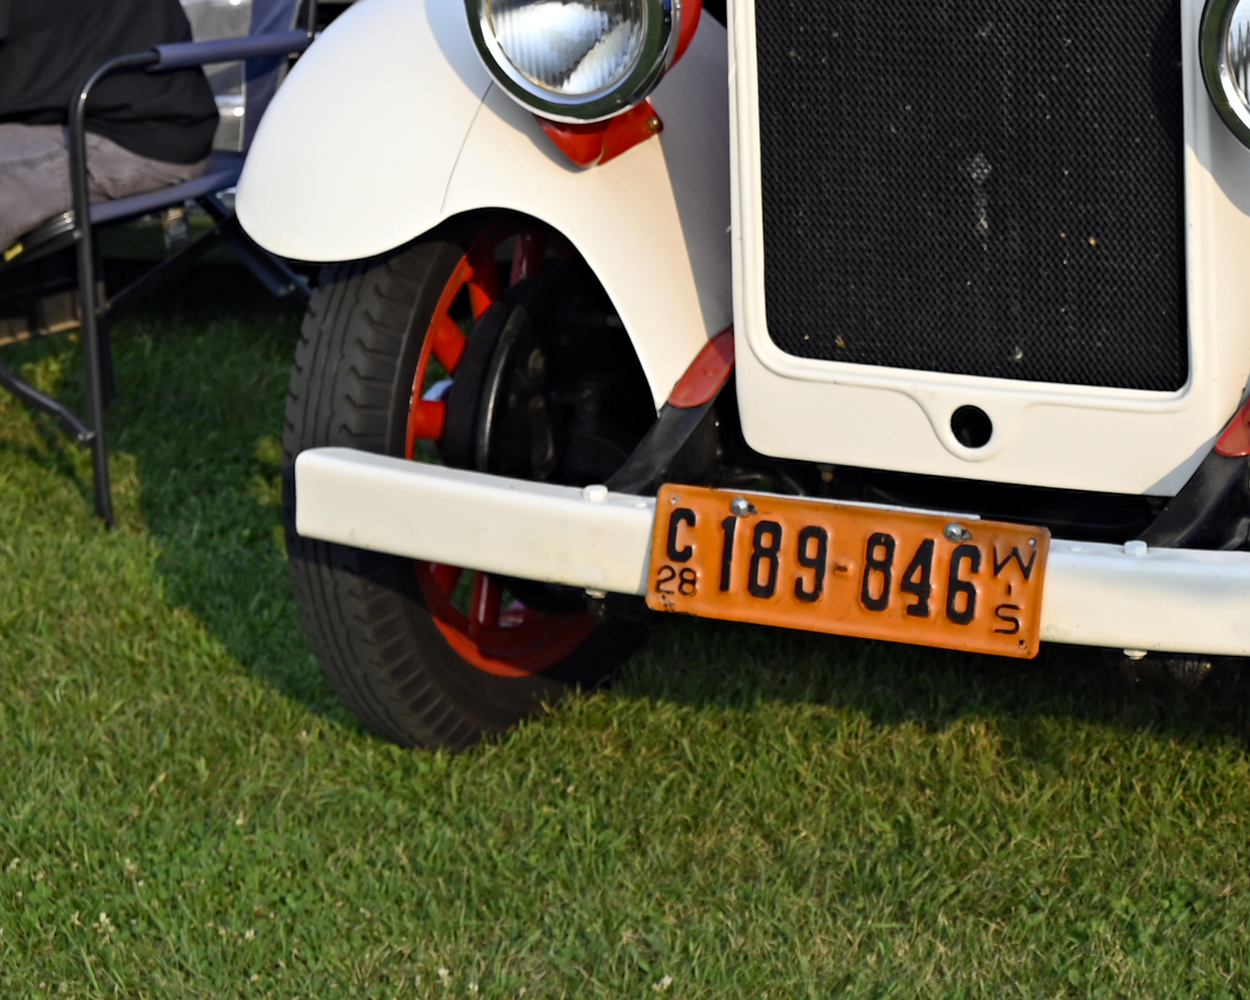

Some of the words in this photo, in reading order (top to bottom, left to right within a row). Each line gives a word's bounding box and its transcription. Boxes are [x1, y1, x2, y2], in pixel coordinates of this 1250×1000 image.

[656, 565, 698, 597] 28
[666, 507, 697, 563] C
[719, 514, 982, 625] 189-846
